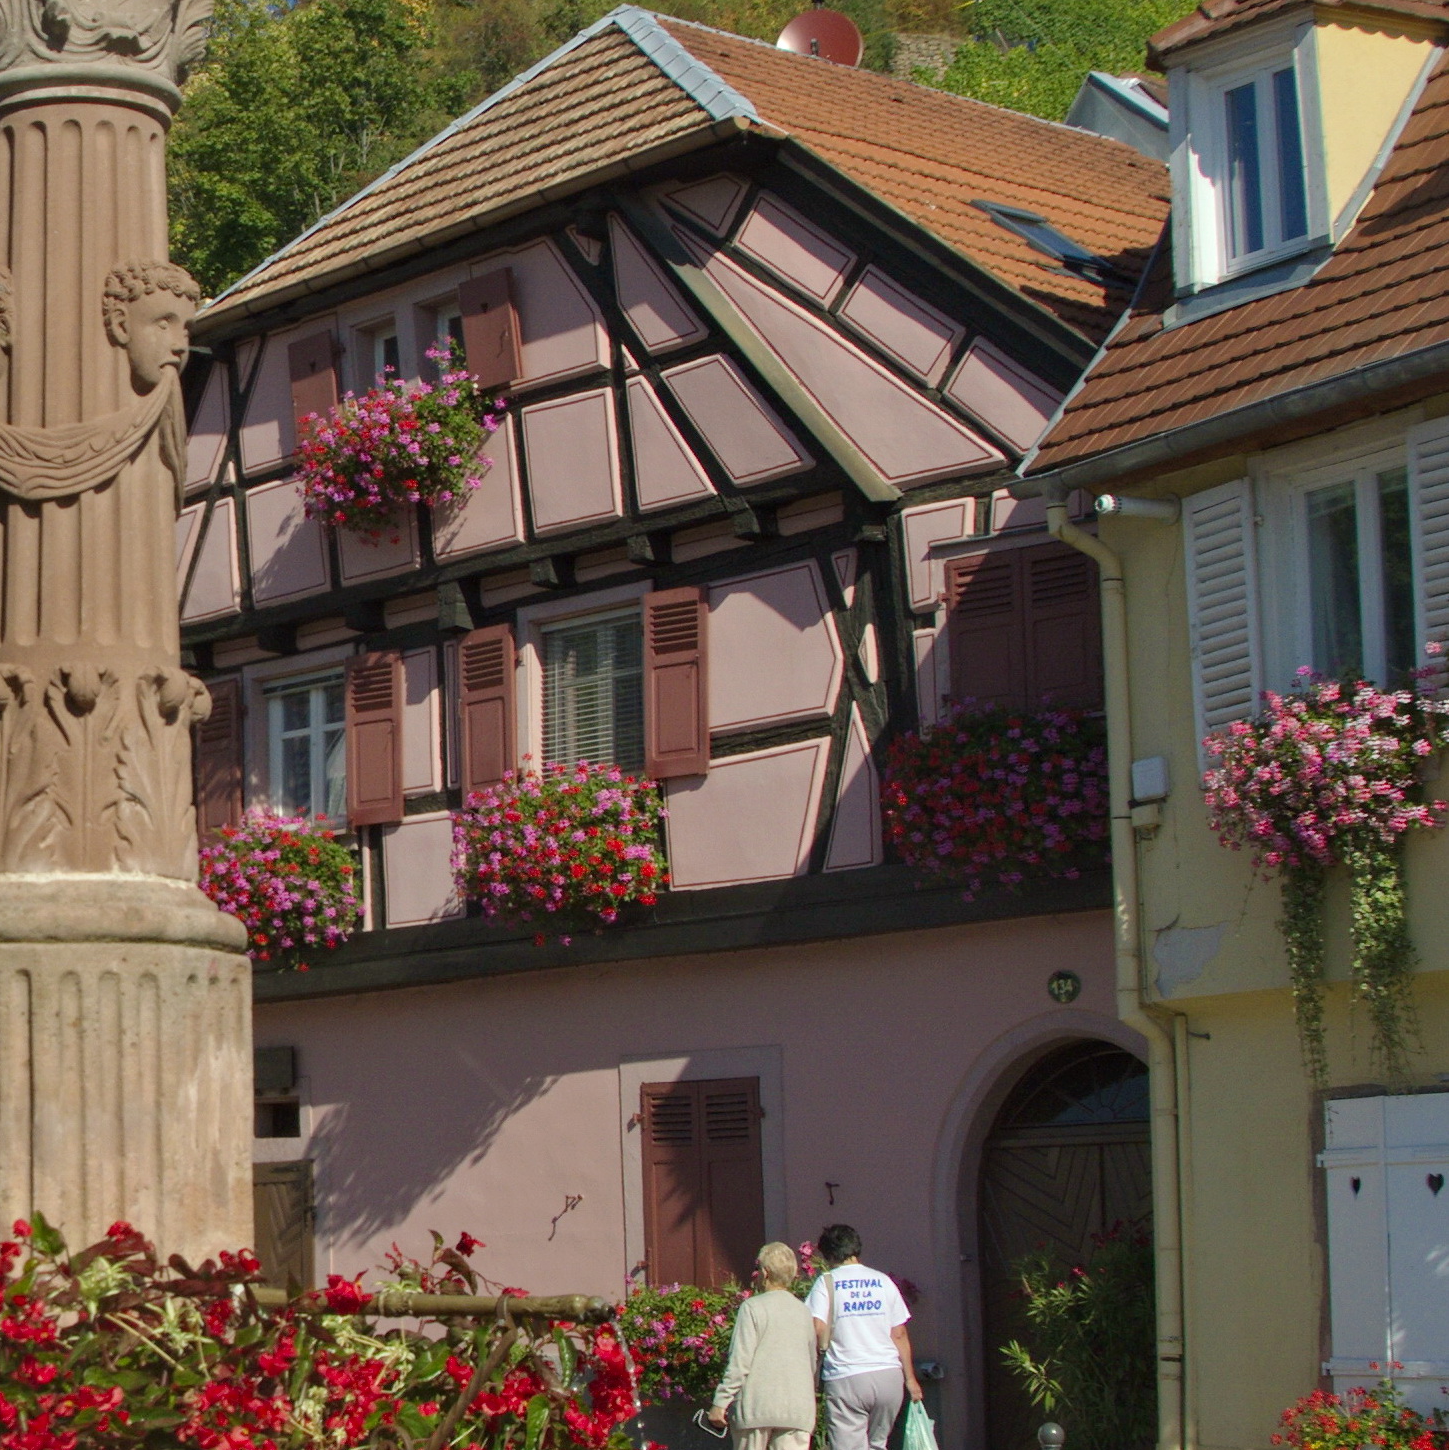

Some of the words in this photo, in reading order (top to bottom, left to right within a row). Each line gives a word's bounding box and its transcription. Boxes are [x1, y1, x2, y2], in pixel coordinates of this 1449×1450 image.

[1051, 979, 1073, 995] 134
[835, 1279, 883, 1291] FESTIVAL
[843, 1300, 882, 1312] RANDO
